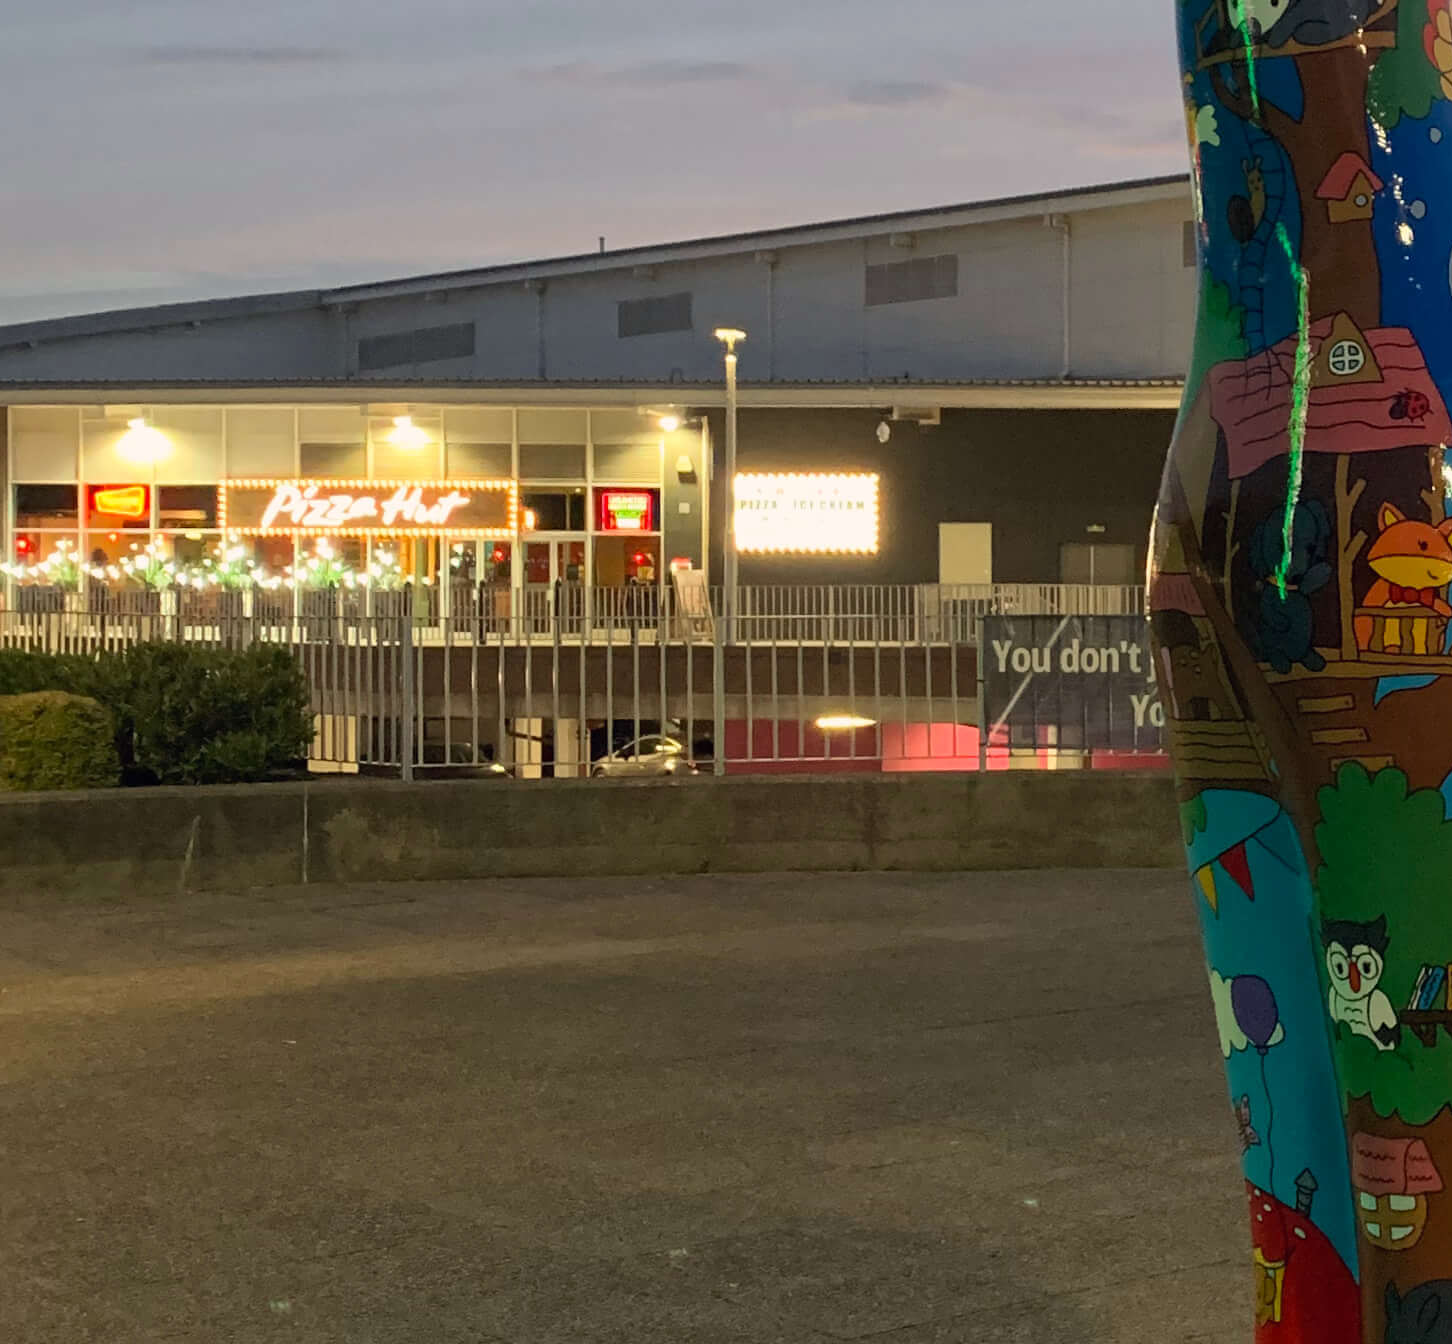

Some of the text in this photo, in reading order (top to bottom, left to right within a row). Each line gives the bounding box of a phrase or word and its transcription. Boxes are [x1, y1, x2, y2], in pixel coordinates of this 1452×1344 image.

[261, 484, 471, 528] Pizza Hut
[992, 639, 1051, 673] You
[1060, 638, 1142, 674] don't
[1130, 694, 1165, 728] Yo
